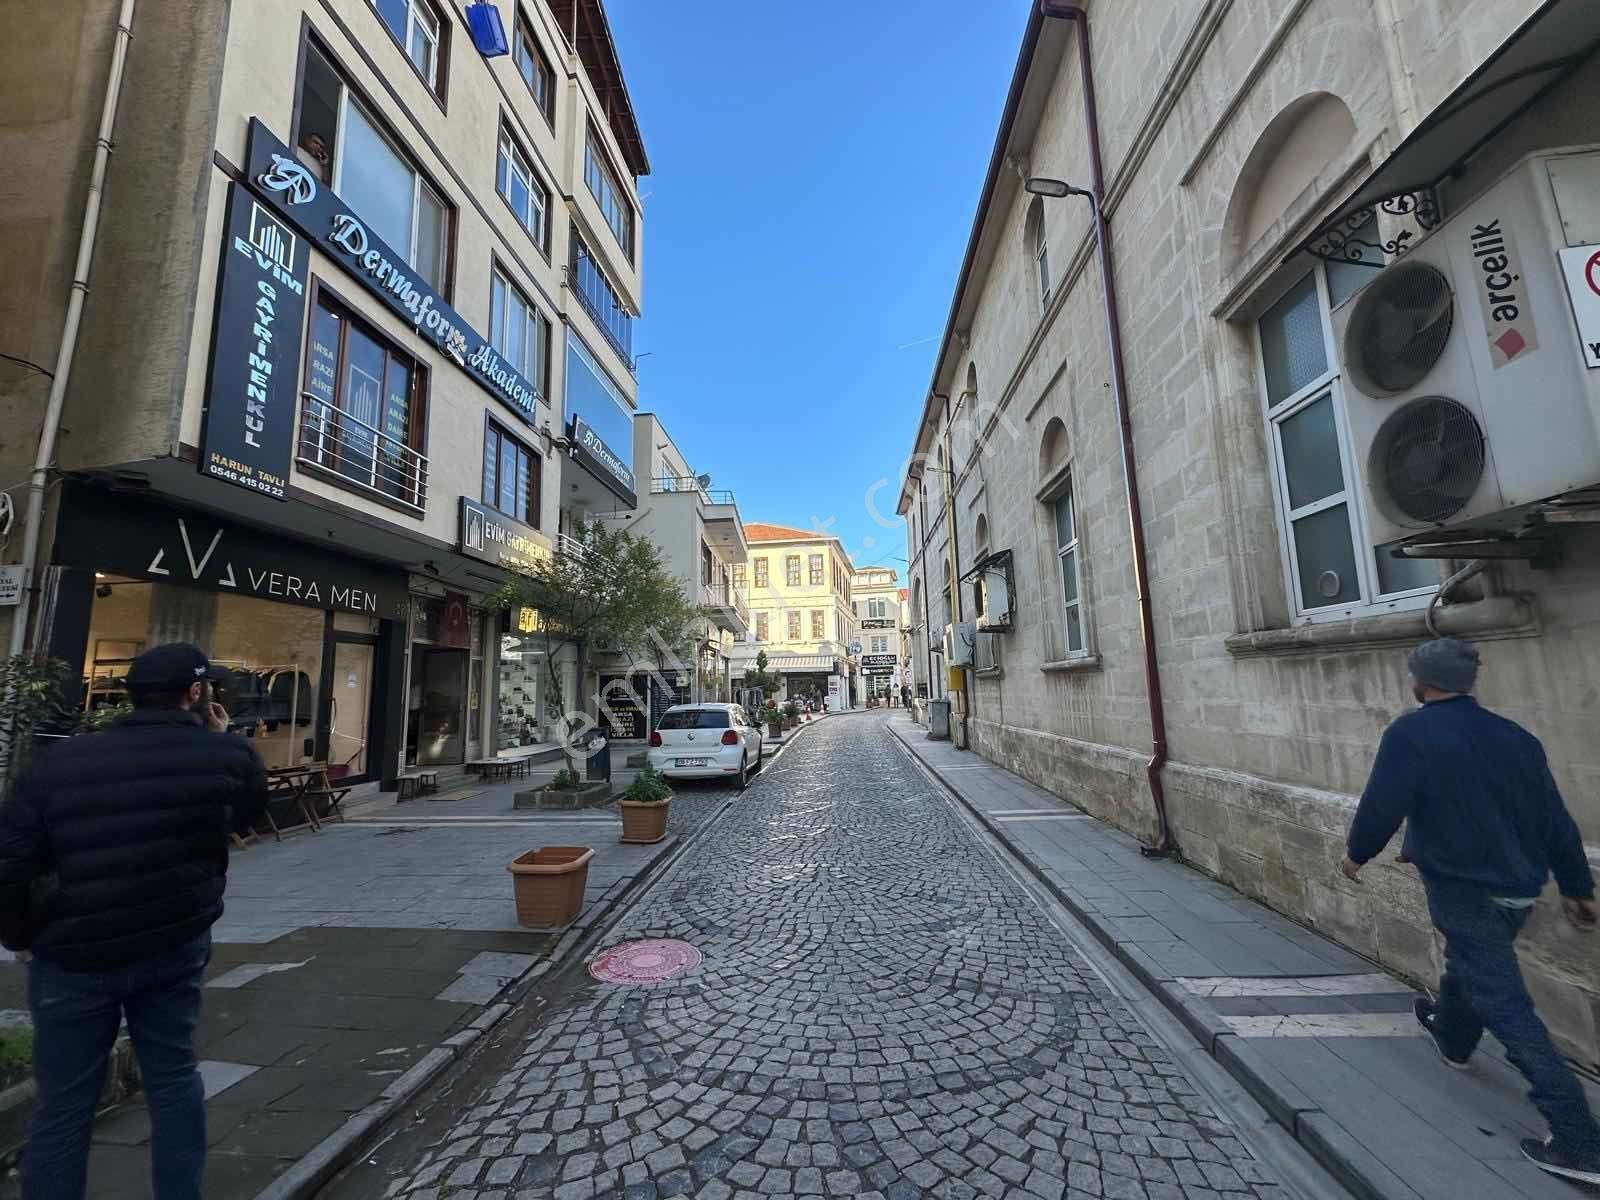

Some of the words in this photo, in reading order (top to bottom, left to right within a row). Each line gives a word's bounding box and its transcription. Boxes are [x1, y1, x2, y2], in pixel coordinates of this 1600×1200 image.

[234, 236, 303, 295] EVİM
[1470, 218, 1520, 322] arçelik
[467, 344, 538, 413] Akademi
[210, 452, 253, 475] HARUN
[210, 464, 237, 481] 0546
[239, 474, 258, 488] 415
[258, 481, 271, 493] 02
[271, 485, 284, 497] 22
[247, 567, 322, 603] VERA
[330, 584, 377, 613] MEN
